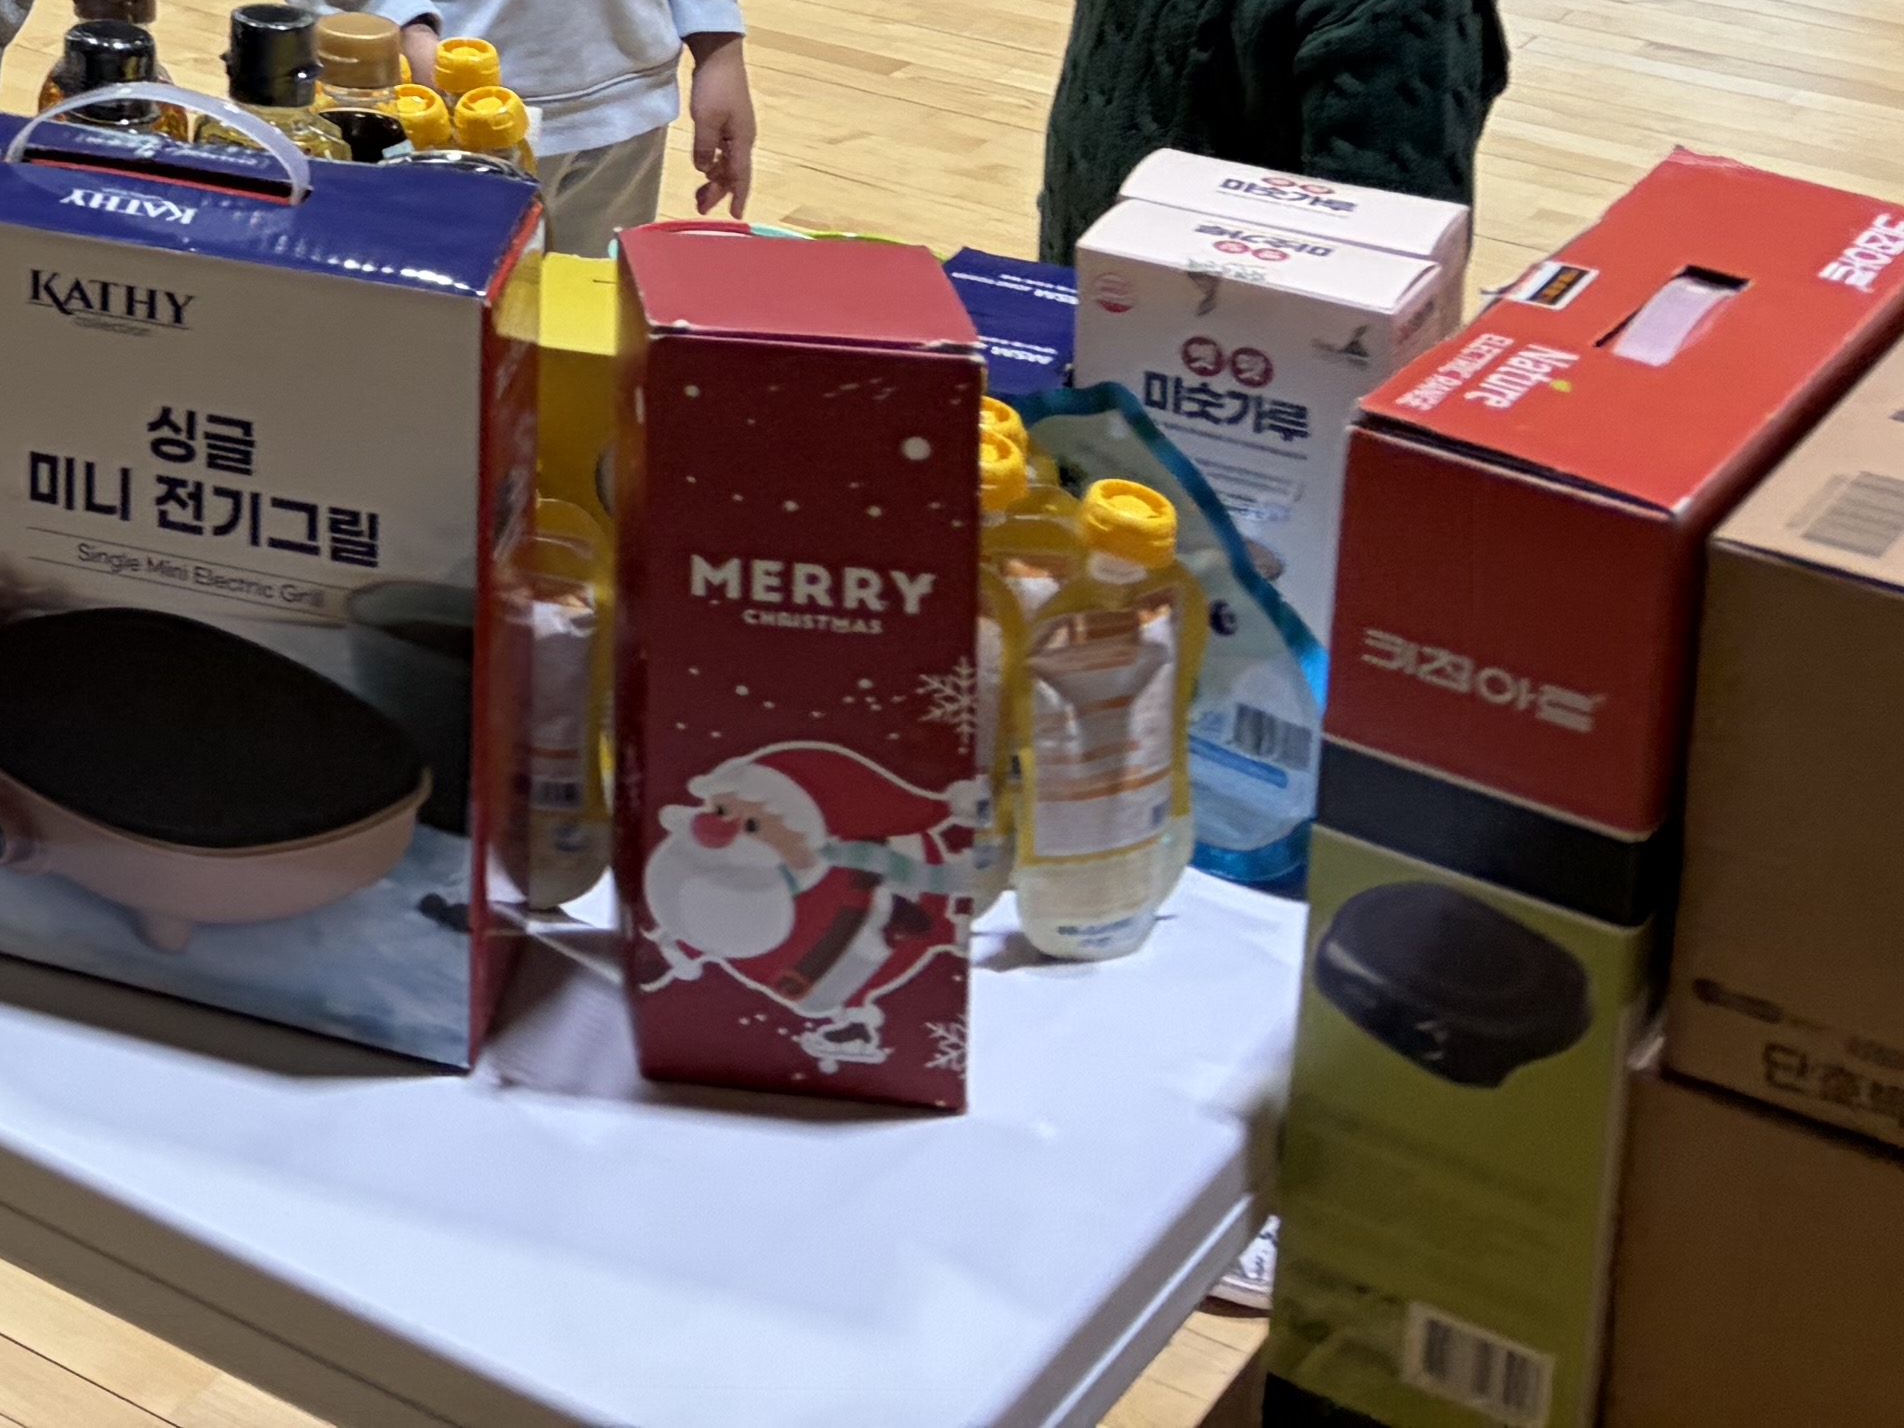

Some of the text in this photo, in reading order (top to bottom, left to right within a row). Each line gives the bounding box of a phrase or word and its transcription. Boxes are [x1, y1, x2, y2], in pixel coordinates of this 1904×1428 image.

[60, 188, 198, 225] KATHY
[1218, 176, 1357, 213] 미숫가루
[27, 268, 195, 327] KATHY
[1143, 370, 1312, 442] 미숫가루
[1464, 343, 1581, 409] Nature
[146, 405, 256, 477] 싱글
[27, 450, 380, 569] 미니 전기그릴
[77, 543, 325, 609] Single Mini Electric Grill
[689, 552, 936, 616] MERRY
[741, 607, 883, 636] CHRISTMAS
